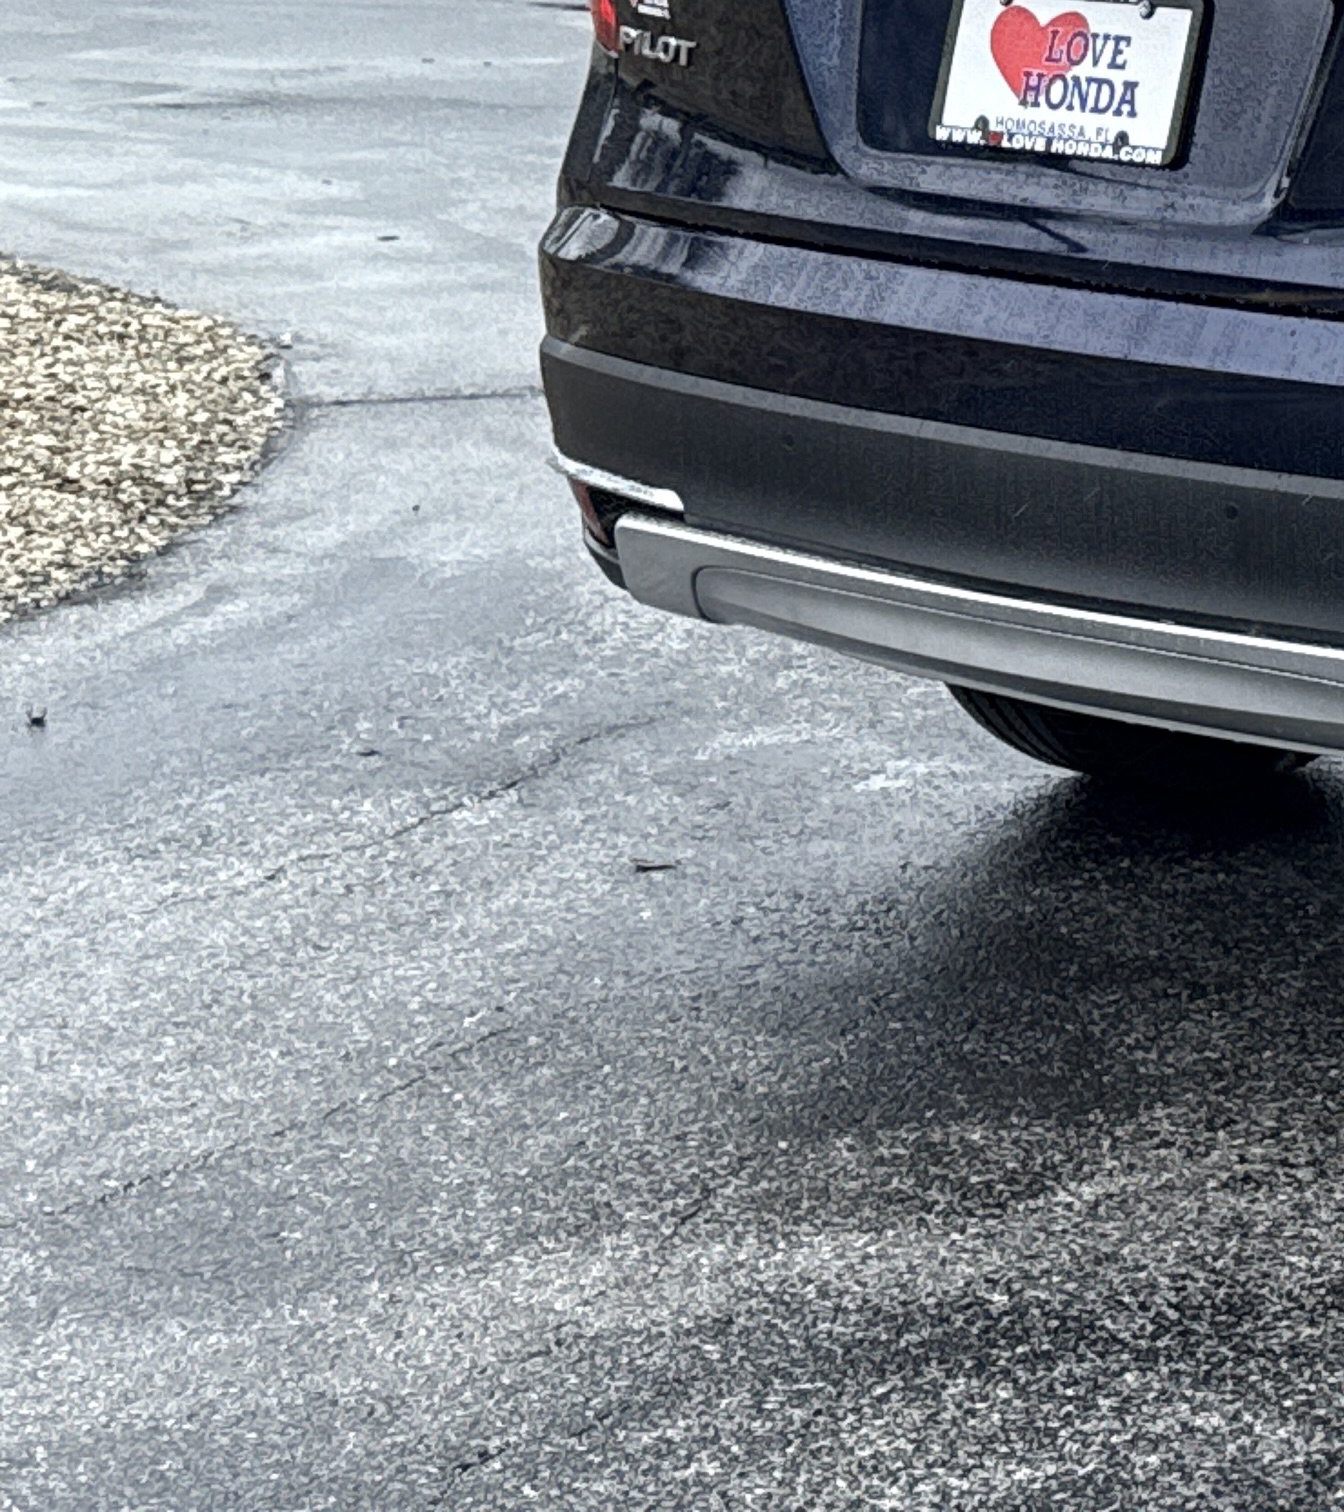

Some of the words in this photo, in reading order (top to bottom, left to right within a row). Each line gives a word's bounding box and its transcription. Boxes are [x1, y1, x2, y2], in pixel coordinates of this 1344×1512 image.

[618, 24, 698, 67] PILOT
[1045, 28, 1131, 70] LOVE
[1018, 70, 1140, 118] HONDA
